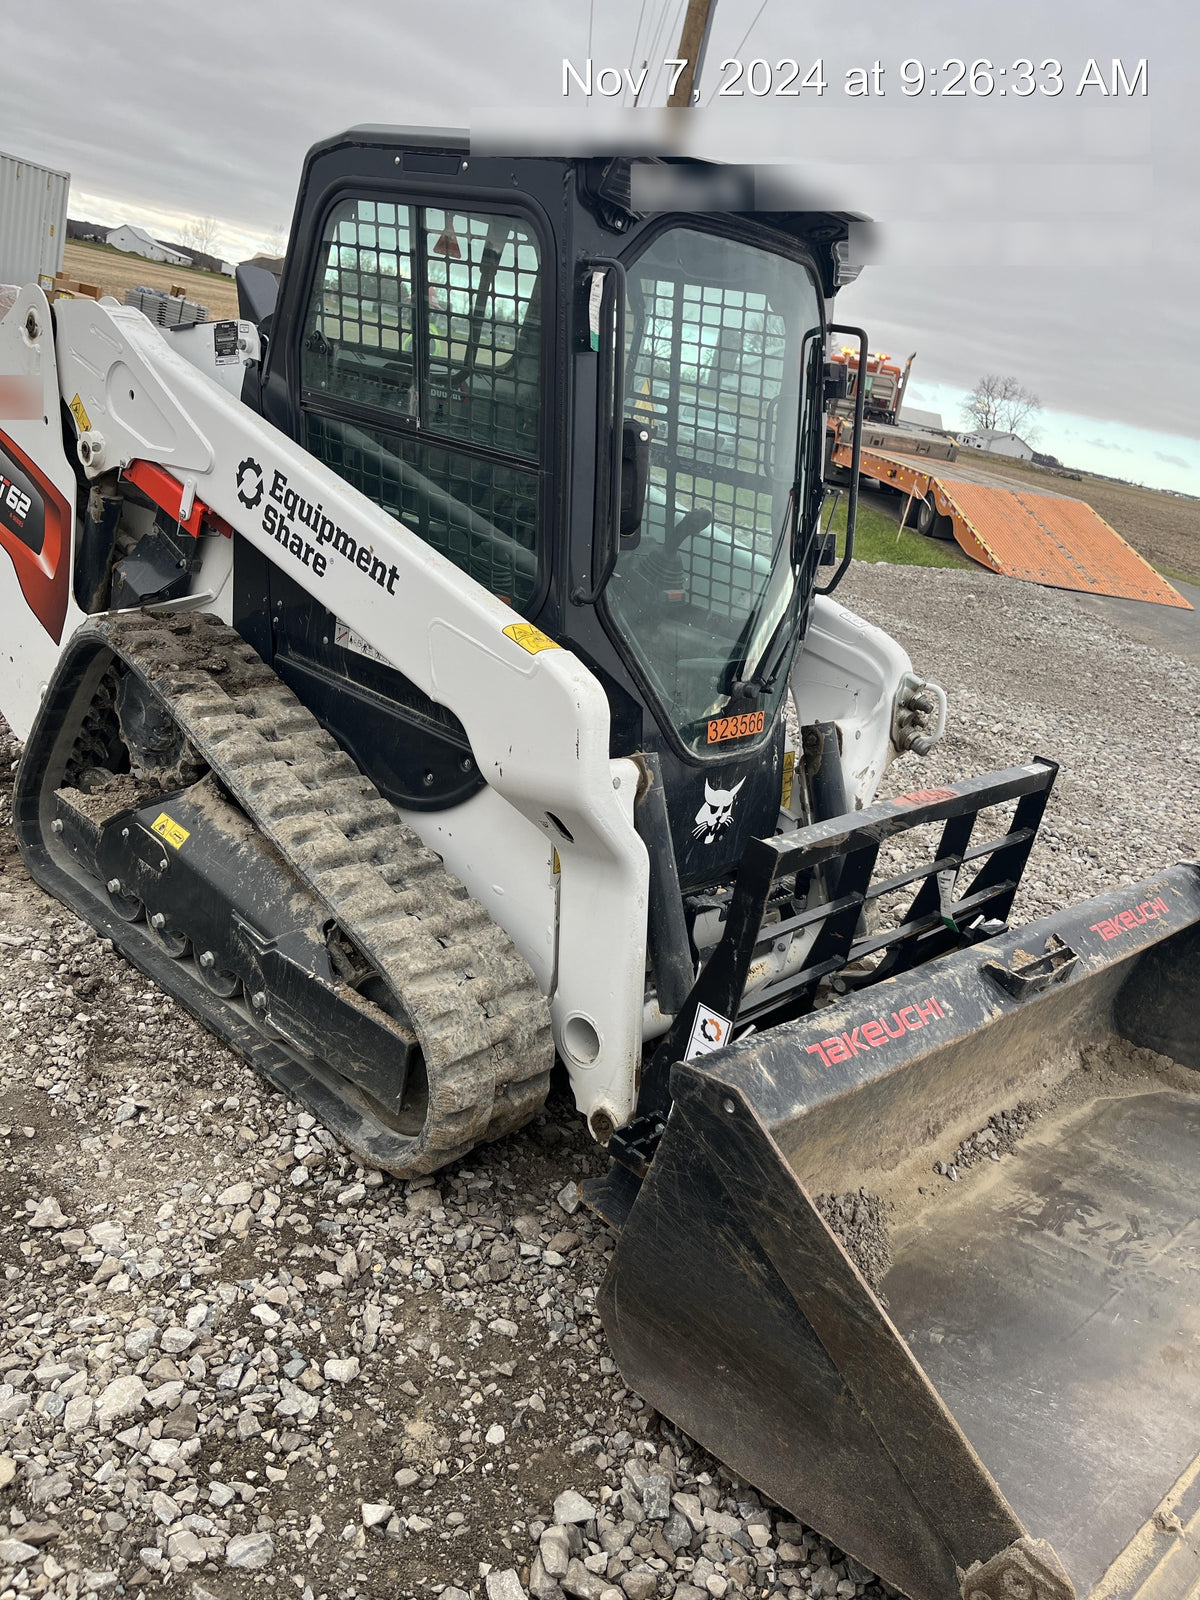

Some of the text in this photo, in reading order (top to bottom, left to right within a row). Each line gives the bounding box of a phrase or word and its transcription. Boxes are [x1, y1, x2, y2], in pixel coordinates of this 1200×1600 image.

[262, 504, 327, 578] Share
[269, 469, 400, 596] Equipment
[709, 711, 764, 742] 323566
